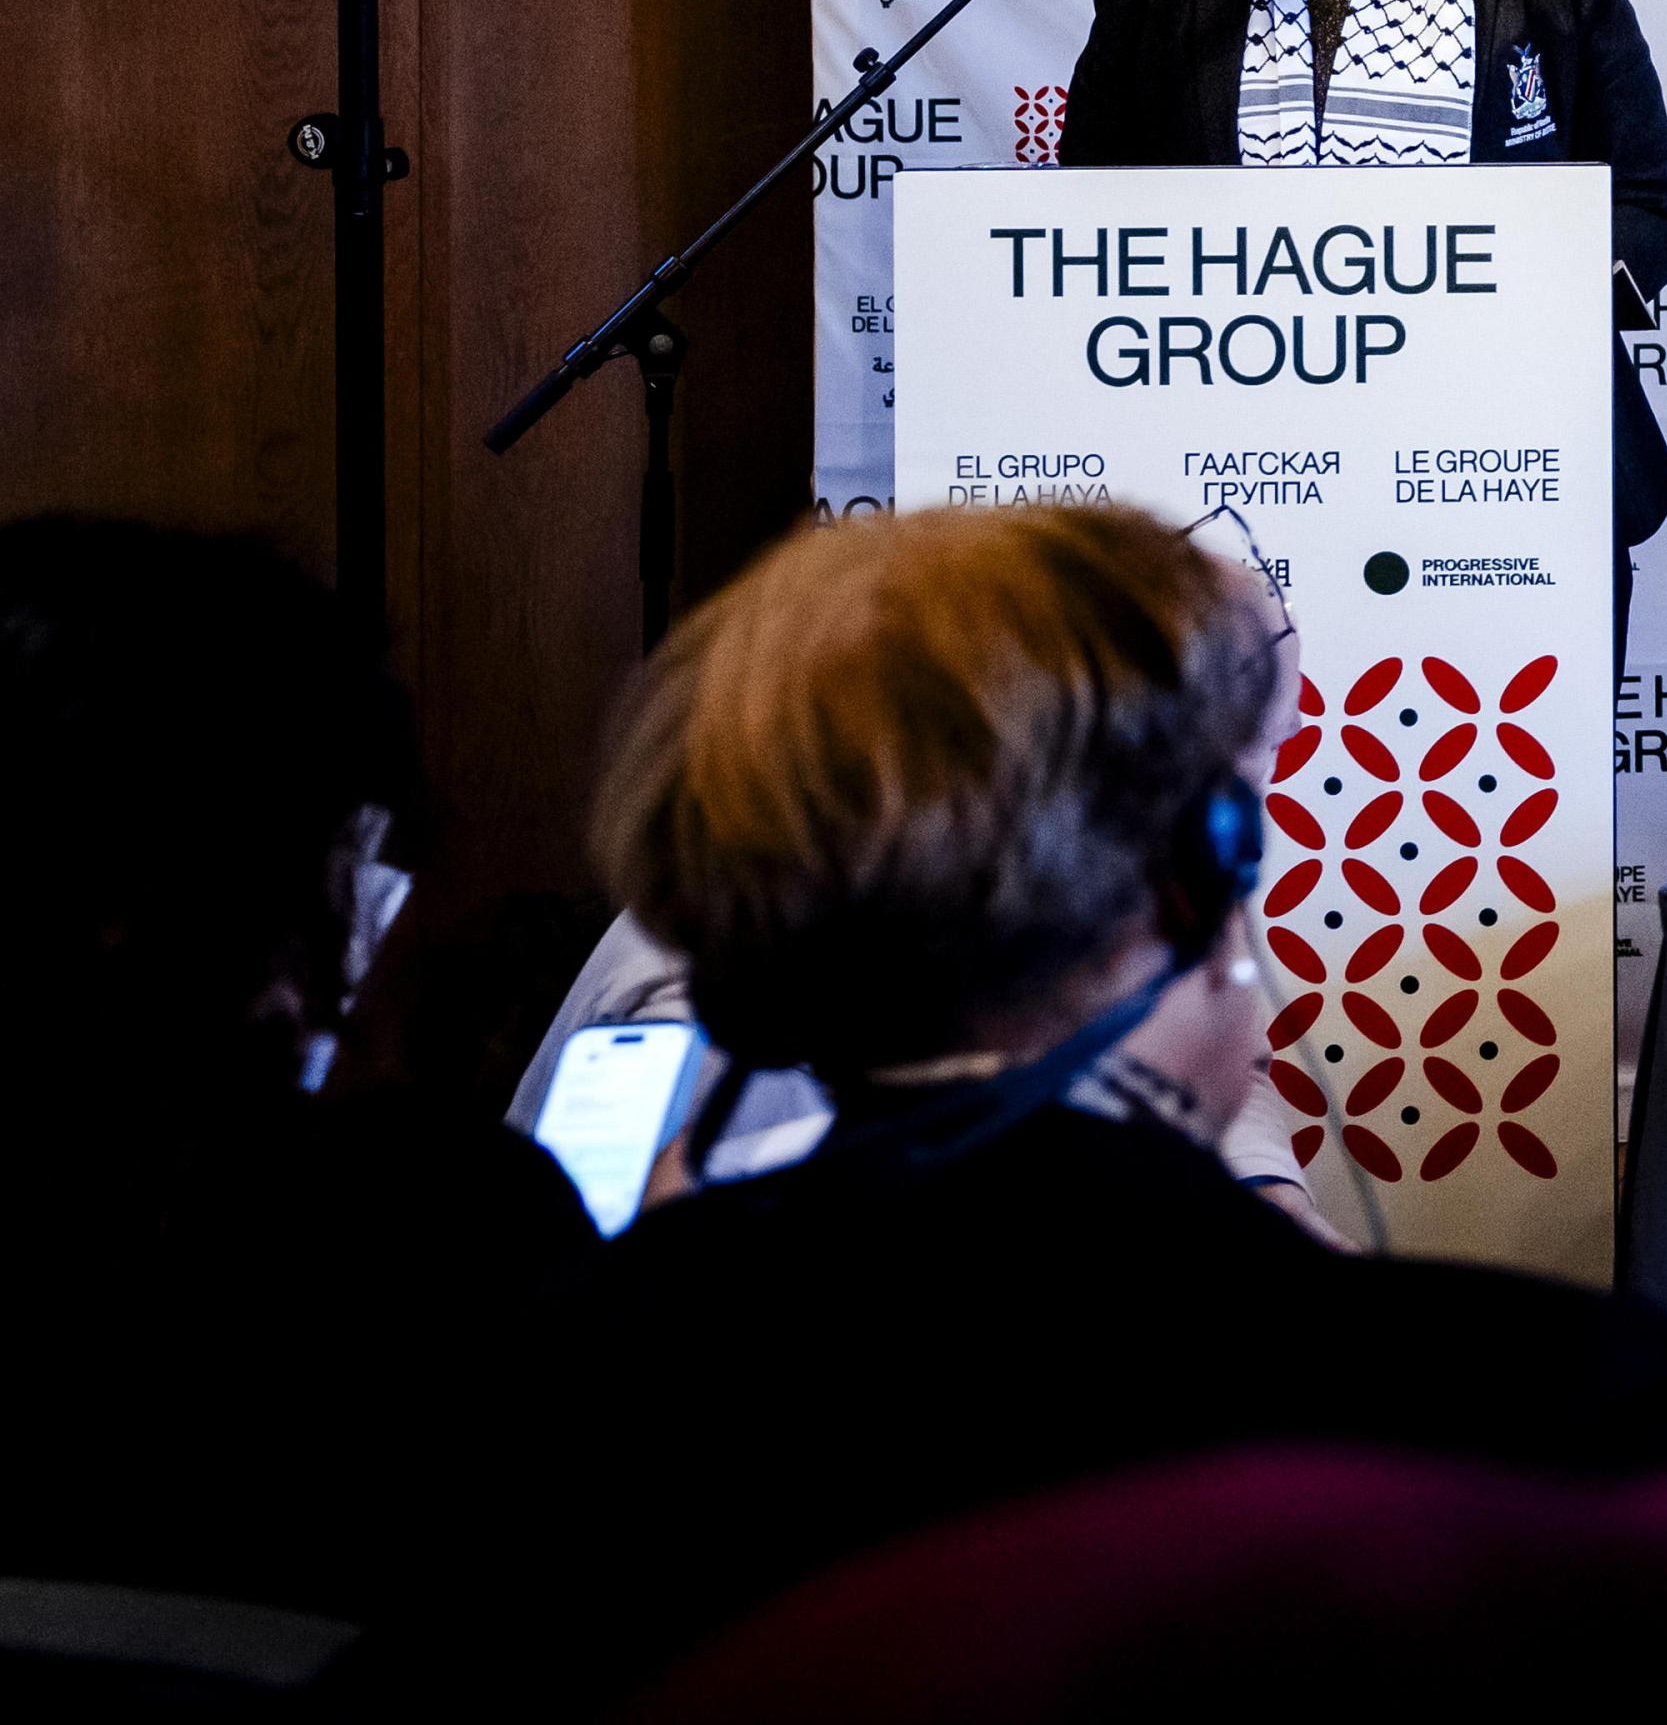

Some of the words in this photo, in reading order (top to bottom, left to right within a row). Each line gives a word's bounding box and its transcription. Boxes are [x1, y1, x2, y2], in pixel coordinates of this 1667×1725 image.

[988, 226, 1171, 299] THE
[1190, 223, 1498, 297] HAGUE
[1085, 313, 1408, 389] GROUP
[956, 455, 993, 479] EL
[997, 453, 1105, 479] GRUPO
[1184, 450, 1340, 476] ГААГСКАЯ
[1395, 450, 1431, 474] LE
[1435, 448, 1561, 474] GROUPE
[1203, 480, 1323, 506] ГРУППА
[1396, 479, 1435, 504] DE
[1441, 479, 1477, 503] LA
[1483, 478, 1560, 502] HAYE
[1422, 557, 1540, 572] PROGRESSIVE
[1422, 572, 1557, 587] INTERNATIONAL
